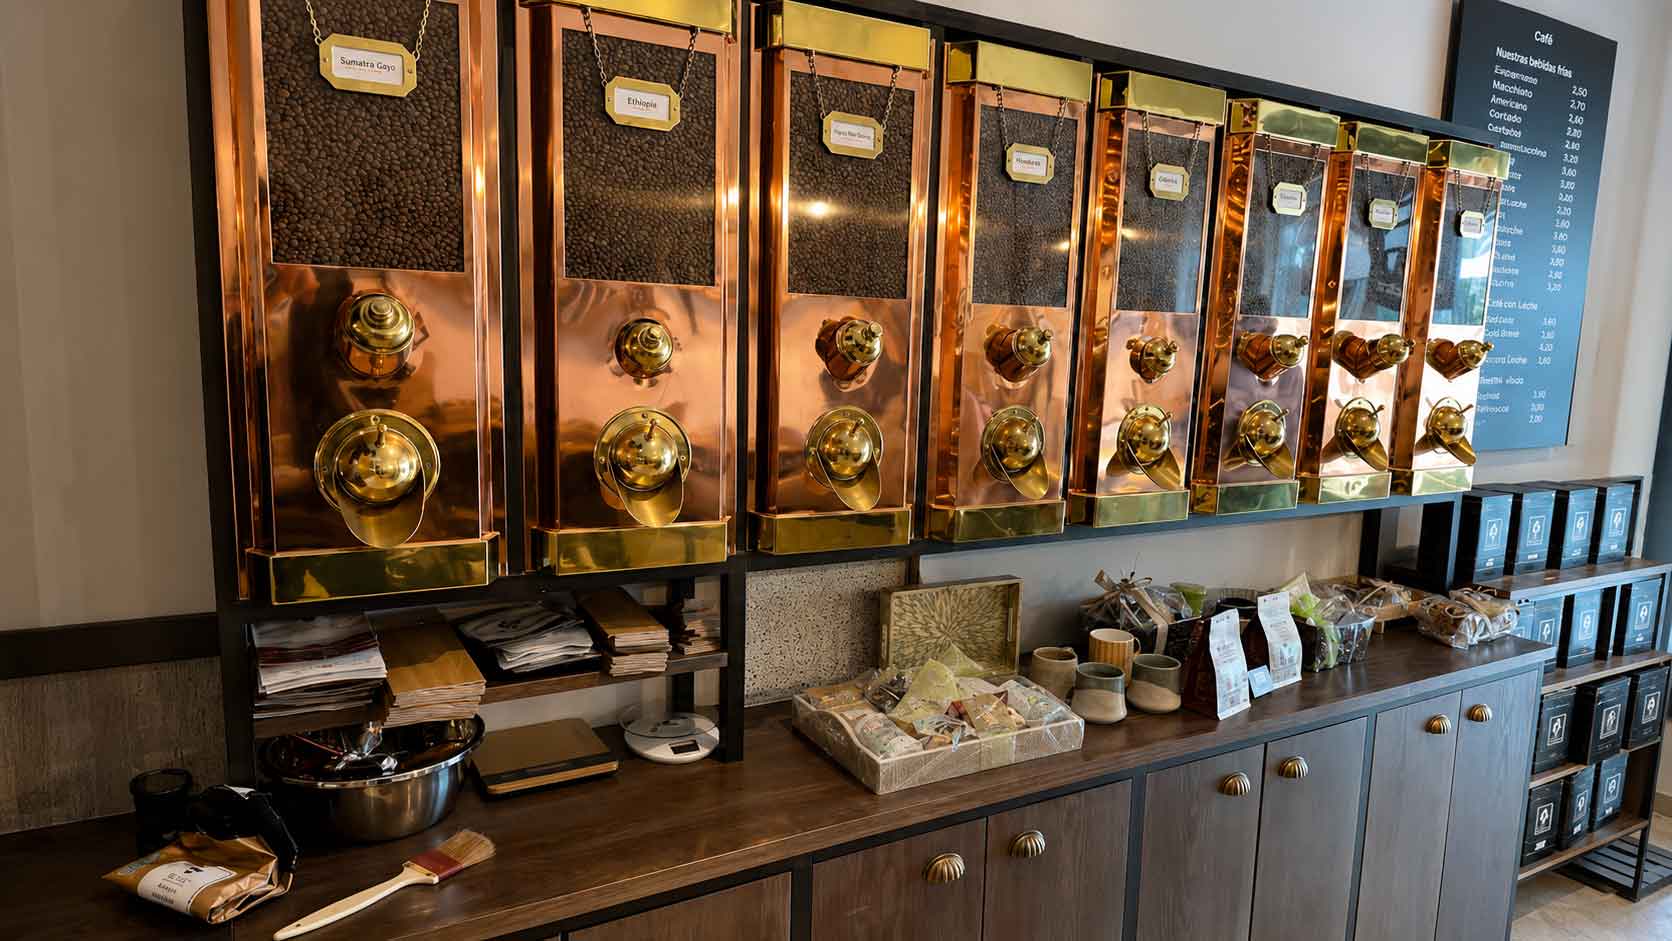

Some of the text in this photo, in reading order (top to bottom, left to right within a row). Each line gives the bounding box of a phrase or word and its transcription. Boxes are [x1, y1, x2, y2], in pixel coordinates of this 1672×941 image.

[1534, 30, 1553, 46] Café
[340, 56, 375, 68] Sumatra
[376, 62, 396, 72] Gayo
[1496, 47, 1529, 65] Nuestras
[1529, 56, 1556, 74] bebidas
[1493, 80, 1533, 98] Macchiato
[1490, 94, 1528, 112] Americano
[1489, 108, 1522, 124] Cortado
